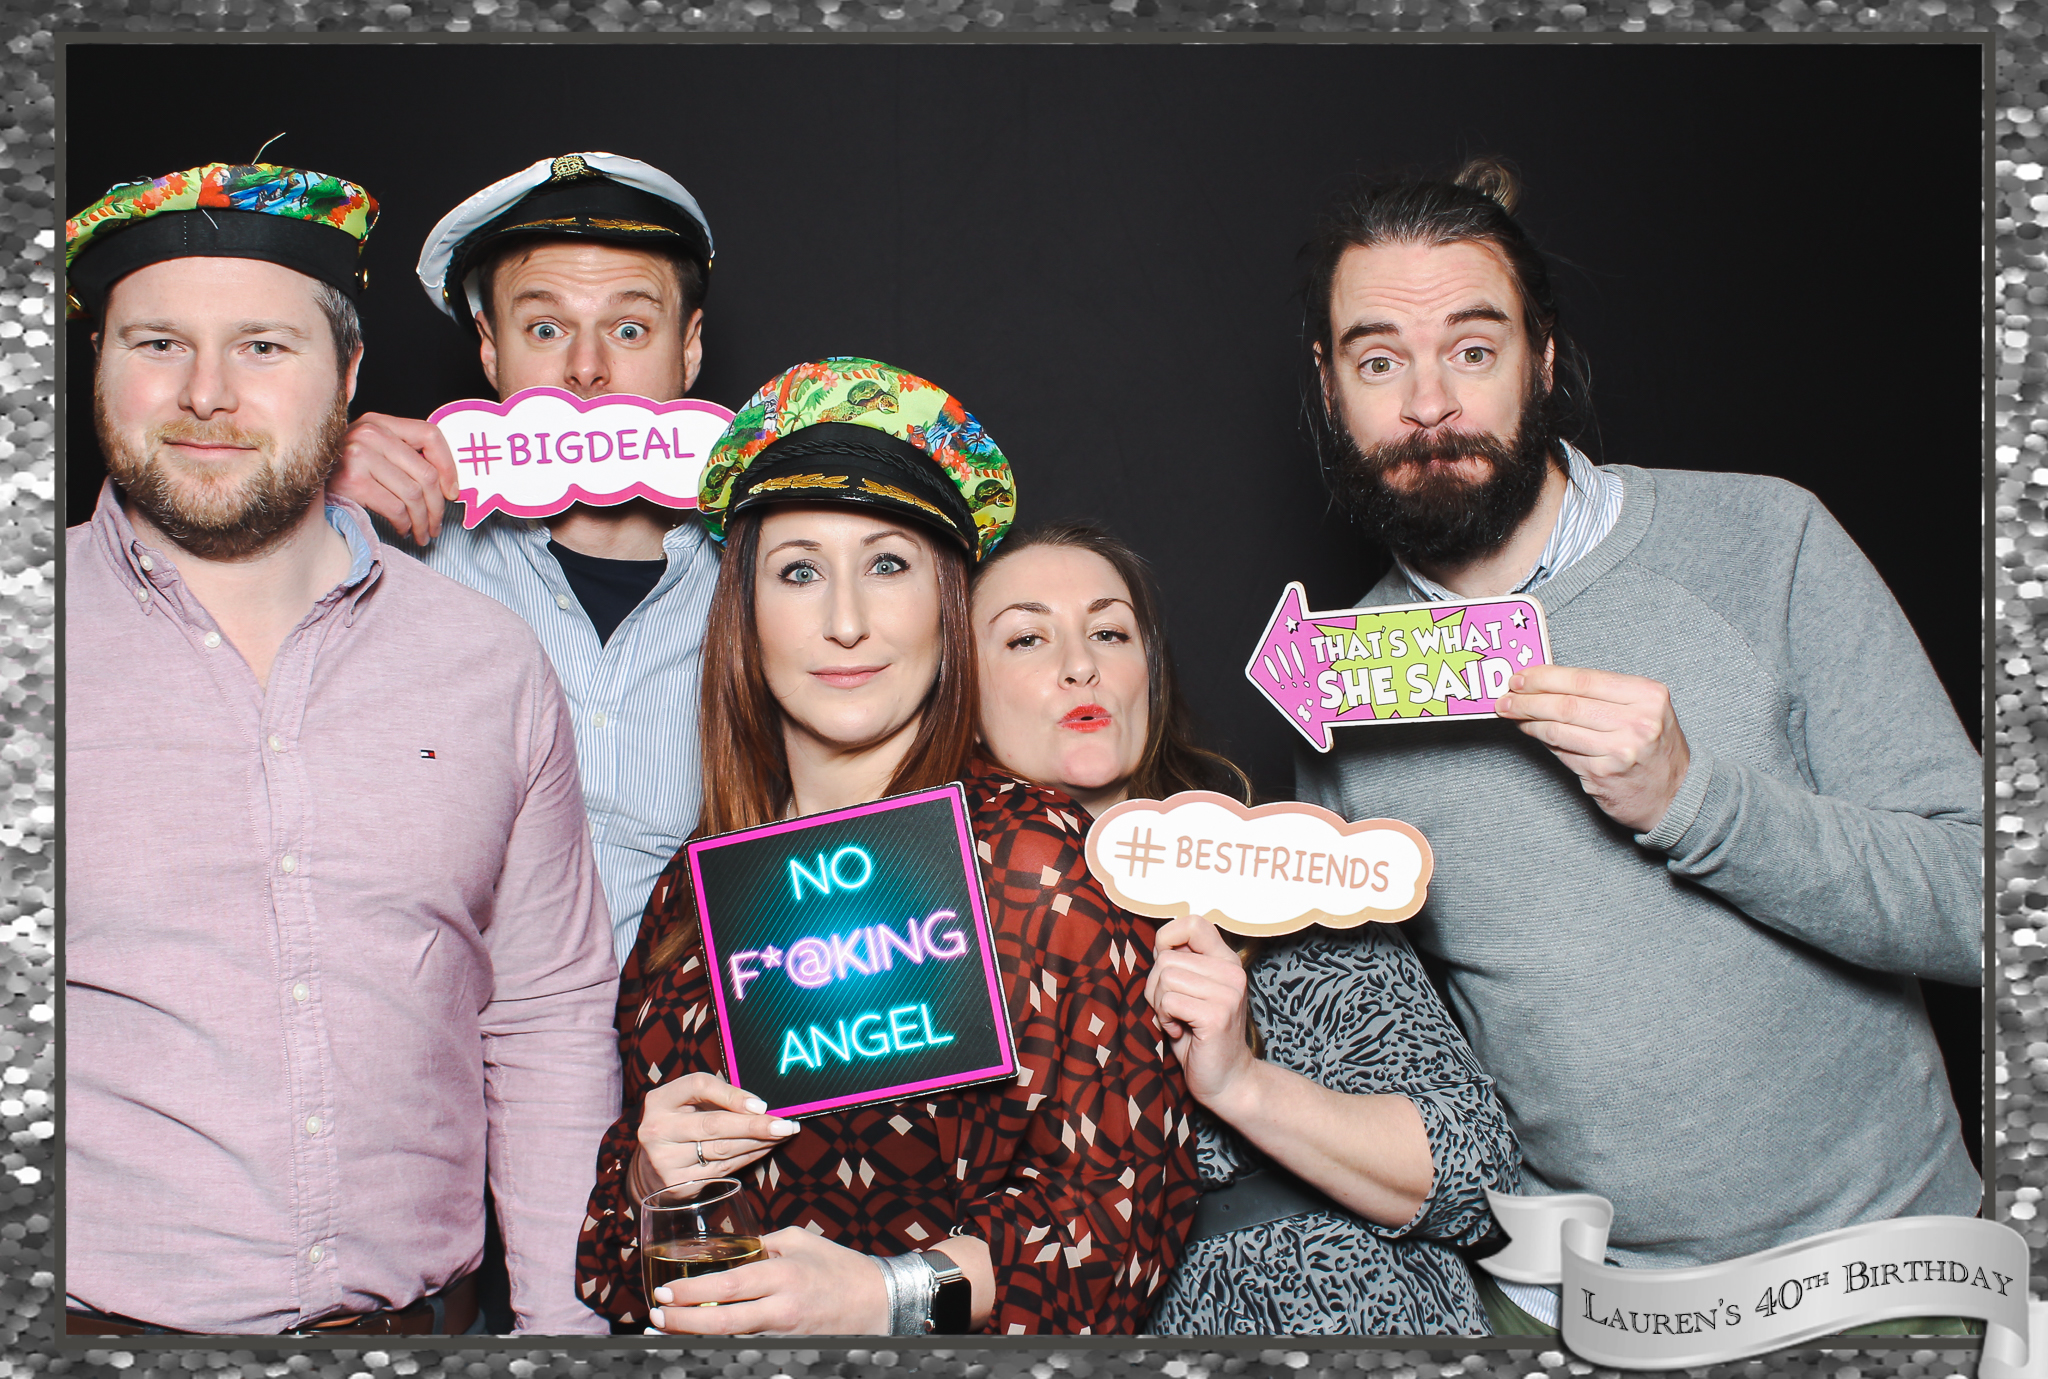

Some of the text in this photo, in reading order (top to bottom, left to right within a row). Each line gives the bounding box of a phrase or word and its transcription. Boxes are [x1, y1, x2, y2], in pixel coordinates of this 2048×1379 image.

[457, 427, 695, 476] #BIGDEAL
[1310, 621, 1503, 663] THAT'S WHAT
[1317, 657, 1515, 710] SHE SAID
[788, 846, 872, 900] NO
[1114, 826, 1390, 893] #BESTFRIENDS
[777, 1003, 954, 1075] ANGEL
